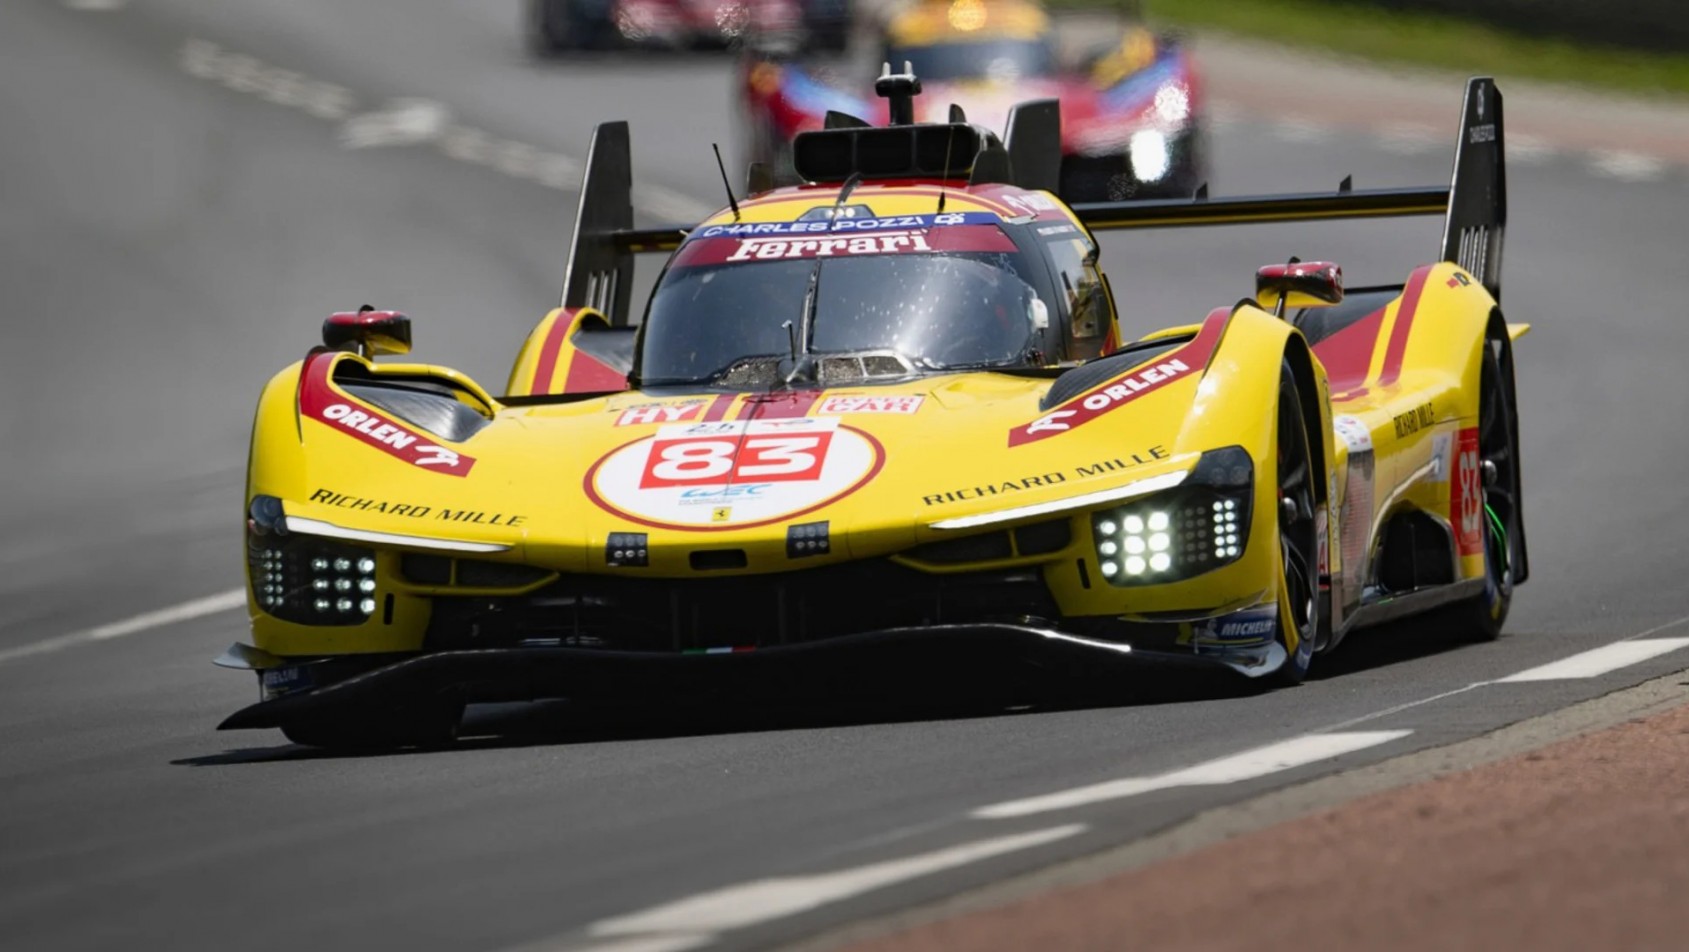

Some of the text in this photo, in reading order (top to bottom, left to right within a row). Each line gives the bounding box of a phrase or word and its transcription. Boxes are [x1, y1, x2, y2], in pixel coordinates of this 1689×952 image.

[702, 216, 924, 238] CHARLES POZZI
[726, 229, 932, 262] Ferrari
[1083, 358, 1189, 411] ORLEN
[322, 404, 417, 450] ORLEN
[618, 403, 704, 426] HY
[824, 401, 913, 413] CAR
[651, 436, 820, 481] 83
[922, 445, 1171, 506] RICHARD MILLE
[308, 488, 528, 528] RICHARD MILLE
